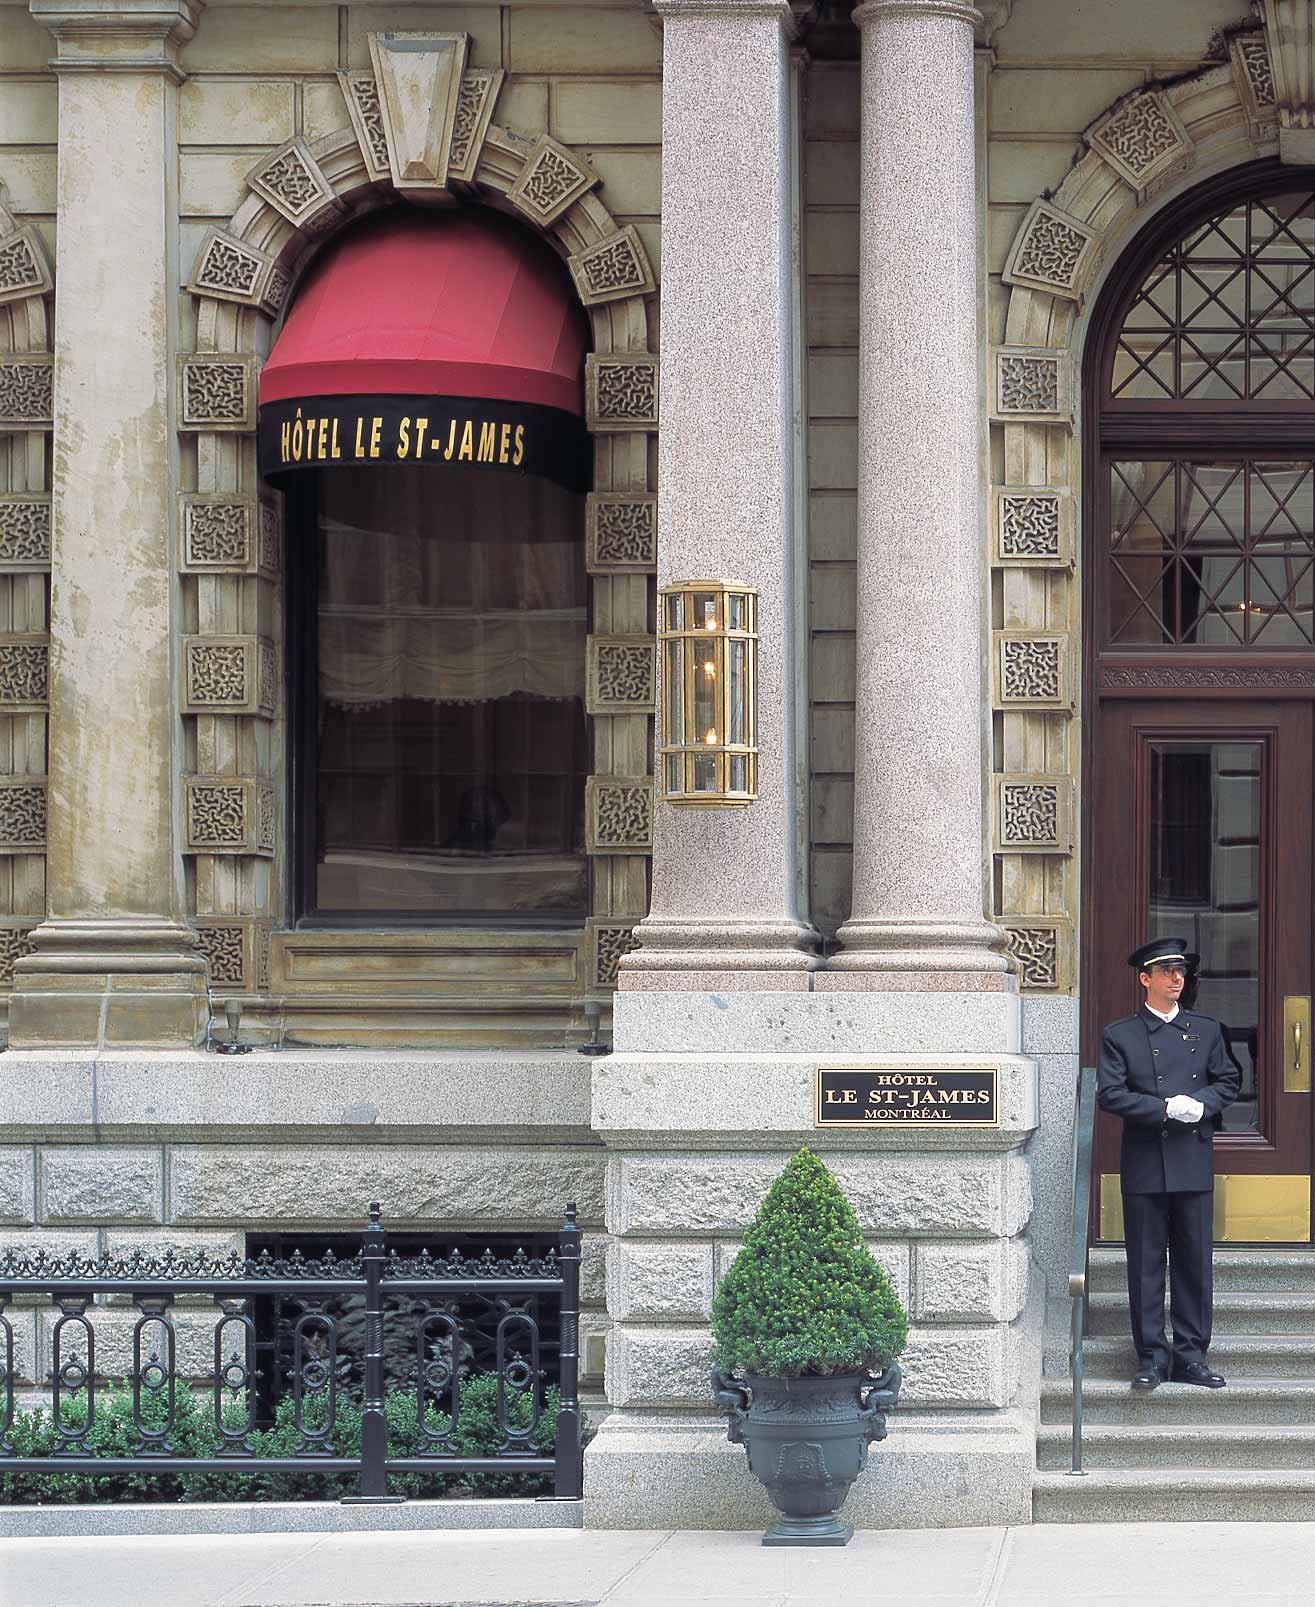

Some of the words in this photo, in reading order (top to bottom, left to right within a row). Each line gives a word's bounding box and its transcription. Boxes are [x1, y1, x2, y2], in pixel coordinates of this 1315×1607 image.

[281, 408, 341, 463] HÔTEL
[355, 417, 383, 458] LE
[397, 416, 525, 466] ST-JAMES
[878, 1074, 938, 1086] HÔTEL
[825, 1090, 858, 1104] LE
[868, 1090, 990, 1108] ST-JAMES
[864, 1107, 951, 1119] MONTRÉAL
